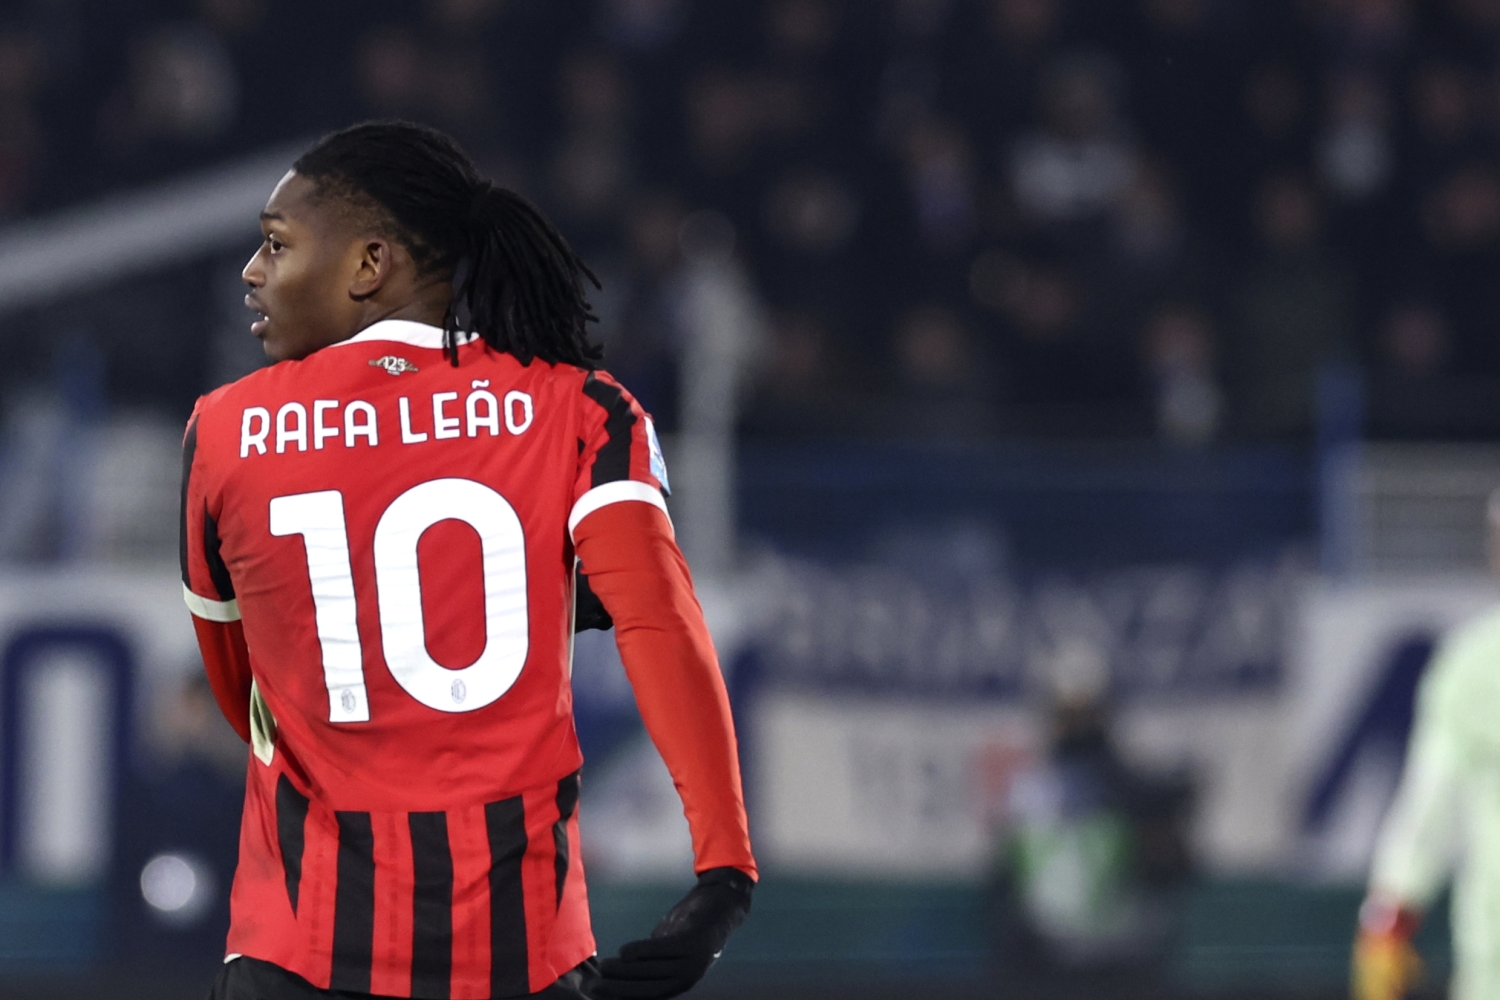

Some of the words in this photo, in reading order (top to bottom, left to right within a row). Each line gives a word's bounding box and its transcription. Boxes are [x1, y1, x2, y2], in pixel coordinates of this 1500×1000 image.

[239, 400, 379, 459] RAFA
[398, 378, 535, 445] LEÃO
[268, 477, 530, 723] 10
